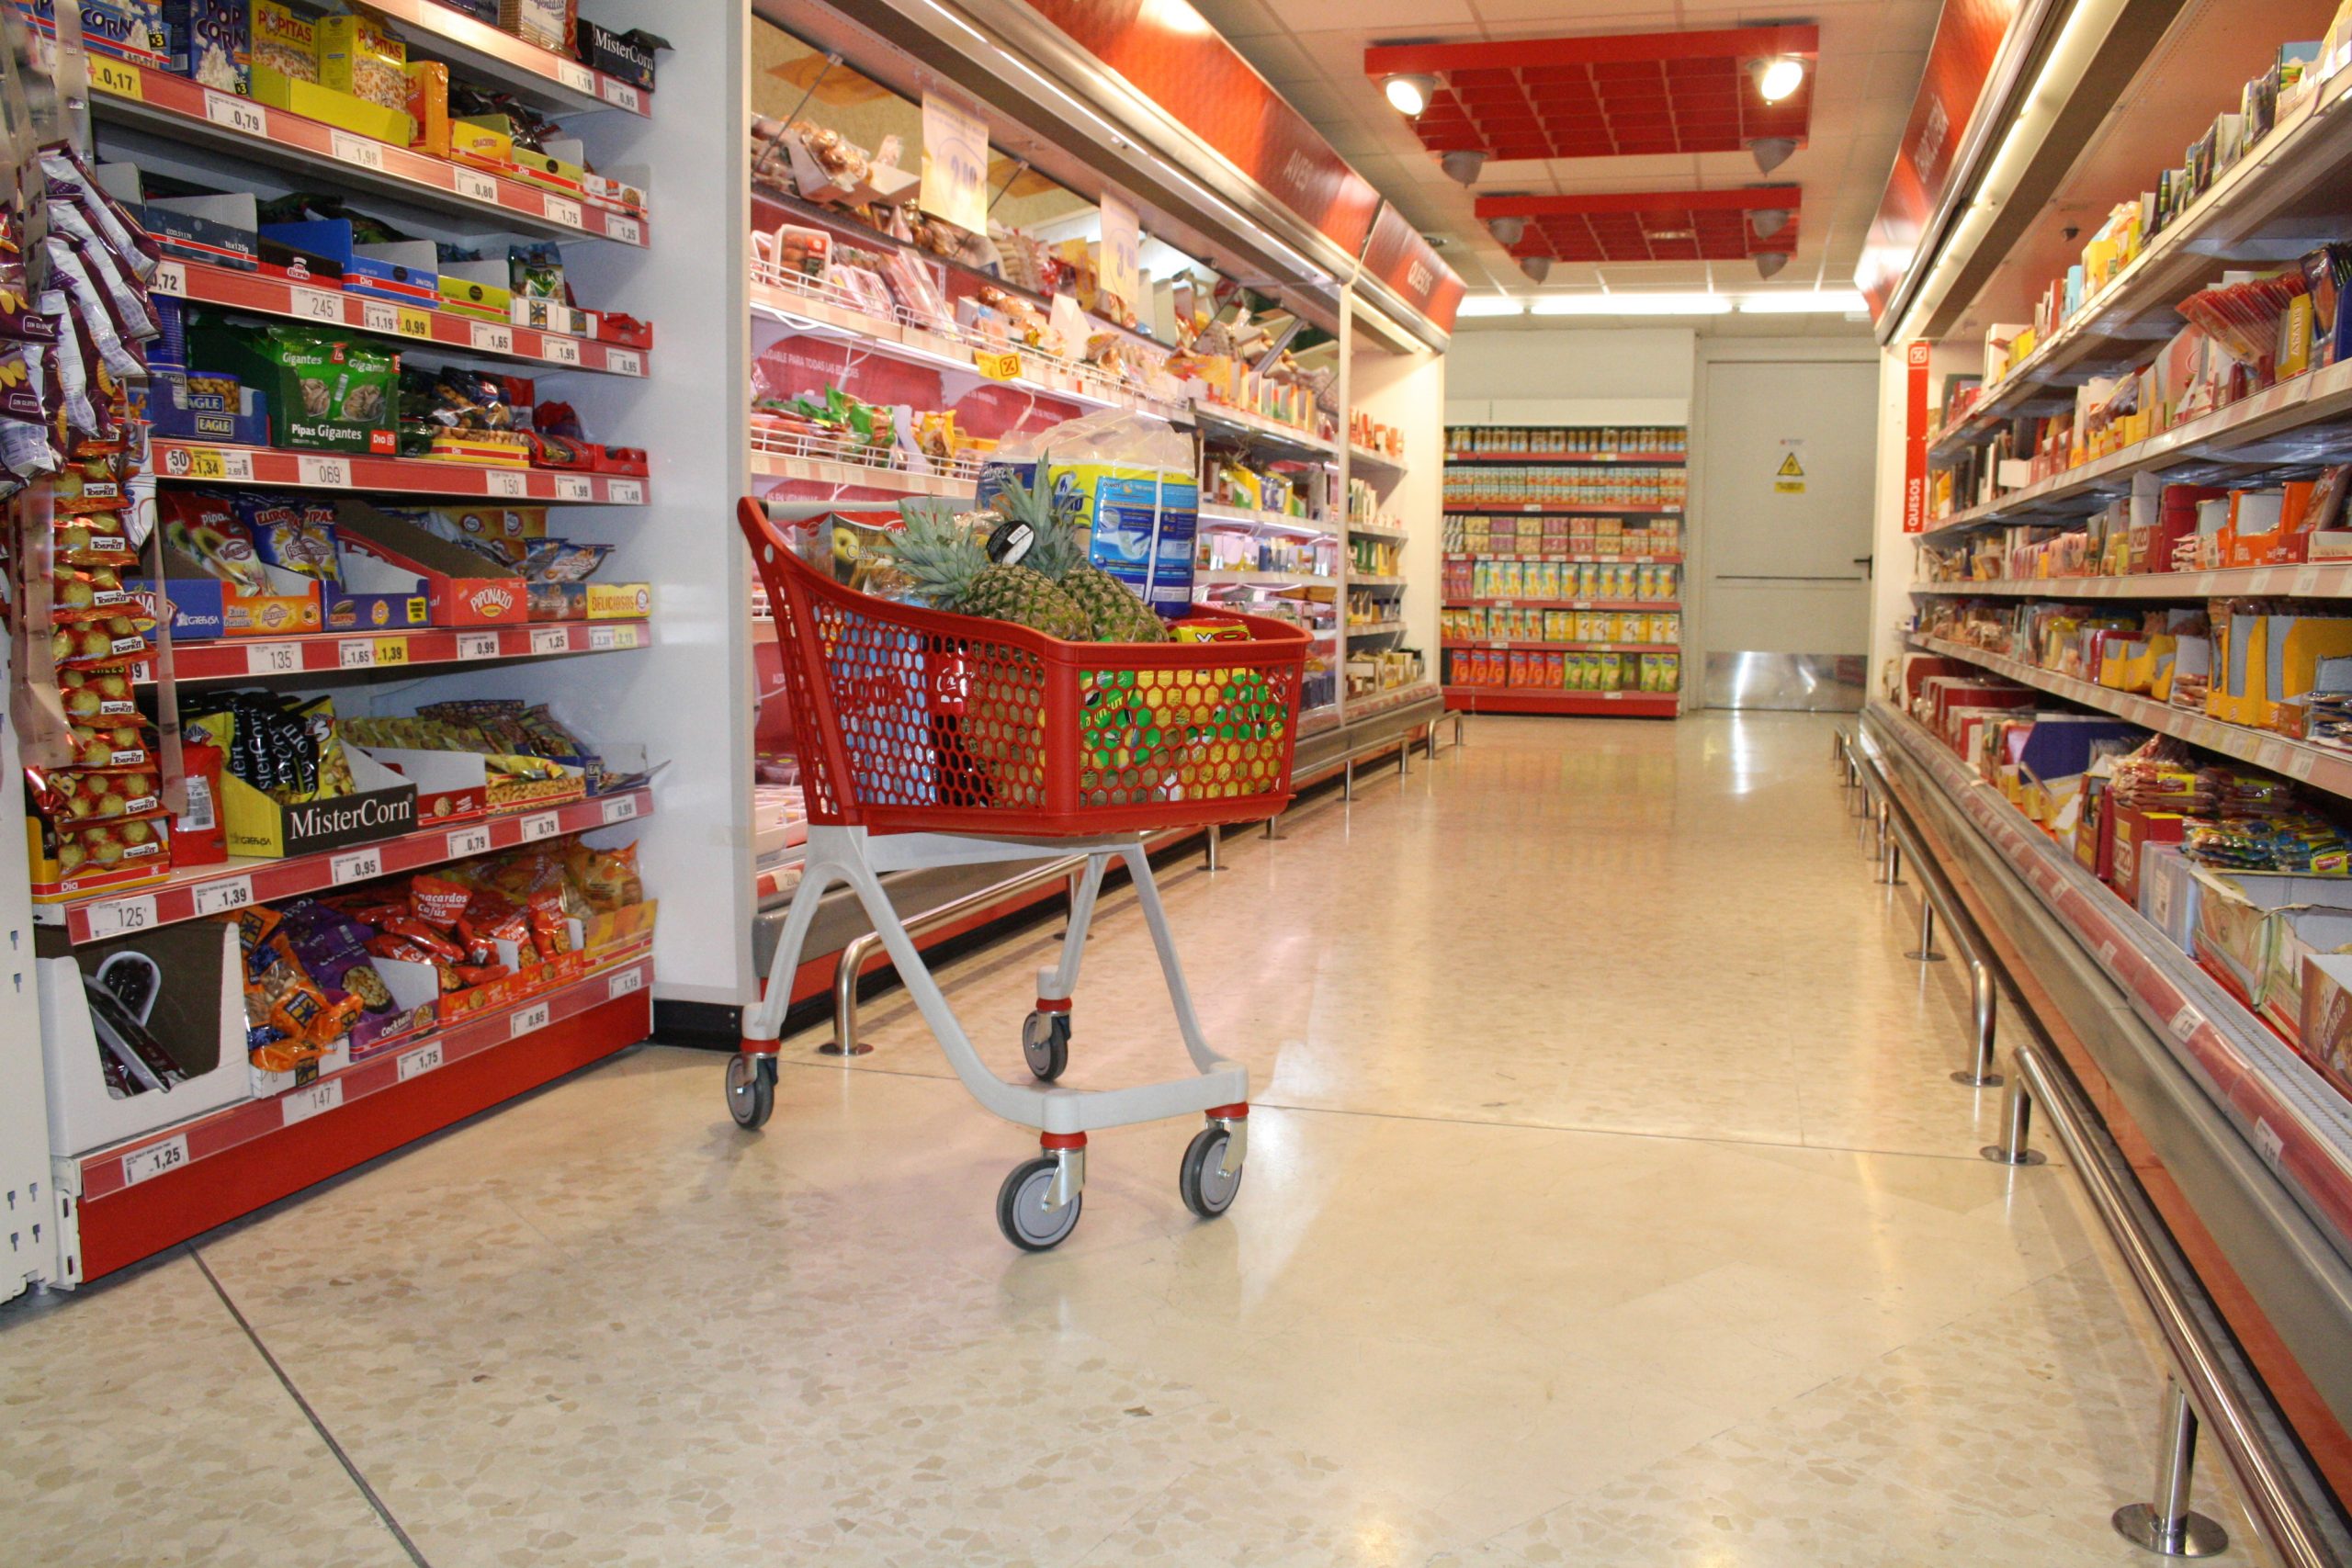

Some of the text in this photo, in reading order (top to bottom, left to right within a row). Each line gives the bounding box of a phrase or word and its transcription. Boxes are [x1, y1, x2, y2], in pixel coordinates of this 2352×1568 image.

[80, 7, 132, 37] CORN
[196, 18, 246, 49] CORN
[258, 9, 312, 43] PPITAS
[357, 28, 402, 60] PPITAS
[594, 28, 654, 72] MisterCorn
[282, 352, 322, 367] Gigantes
[187, 396, 220, 411] AGLE
[198, 418, 231, 434] EAGLE
[291, 423, 362, 440] Pipas Gigantes
[1907, 478, 1921, 527] QUESOS
[469, 587, 514, 614] PIPONAZO
[289, 798, 411, 840] MisterCorn
[61, 881, 79, 892] Dia
[380, 1010, 412, 1037] Cocktail
